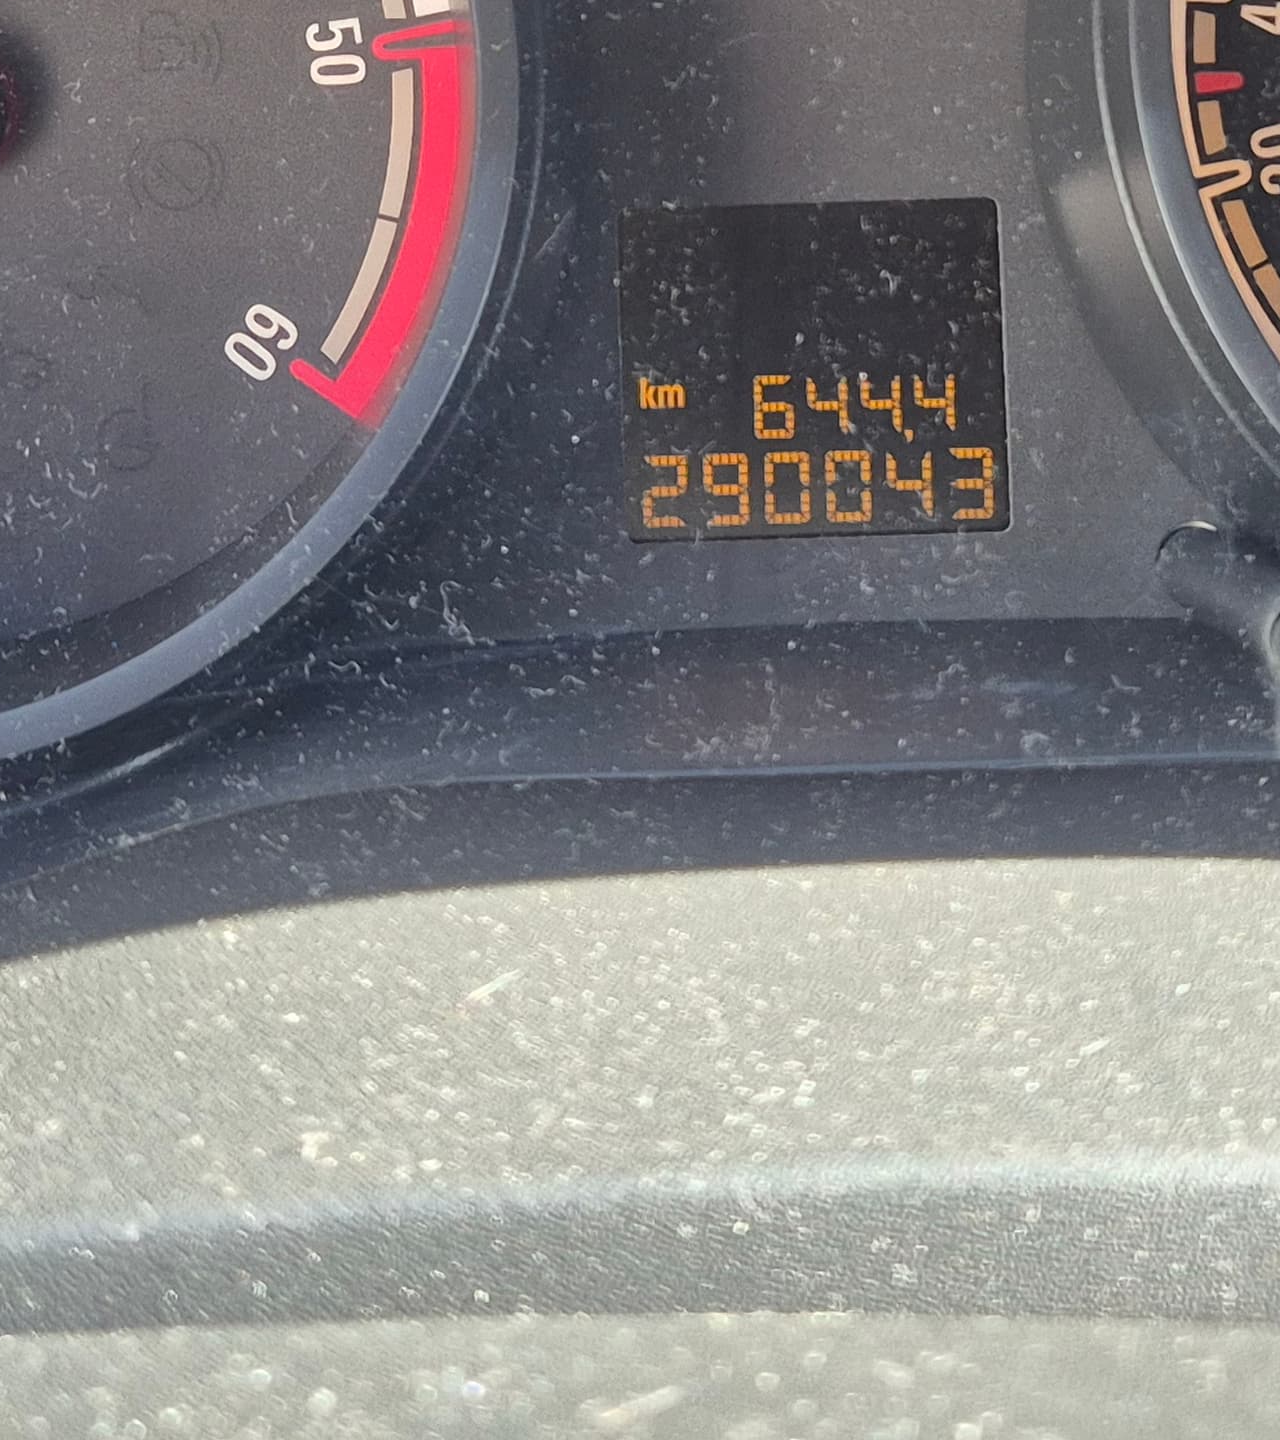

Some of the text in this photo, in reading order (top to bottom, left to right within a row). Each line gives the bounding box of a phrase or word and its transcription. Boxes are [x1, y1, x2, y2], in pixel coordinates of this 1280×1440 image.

[305, 17, 365, 88] 50
[224, 303, 299, 383] 60
[638, 377, 686, 409] km
[642, 446, 996, 529] 290043
